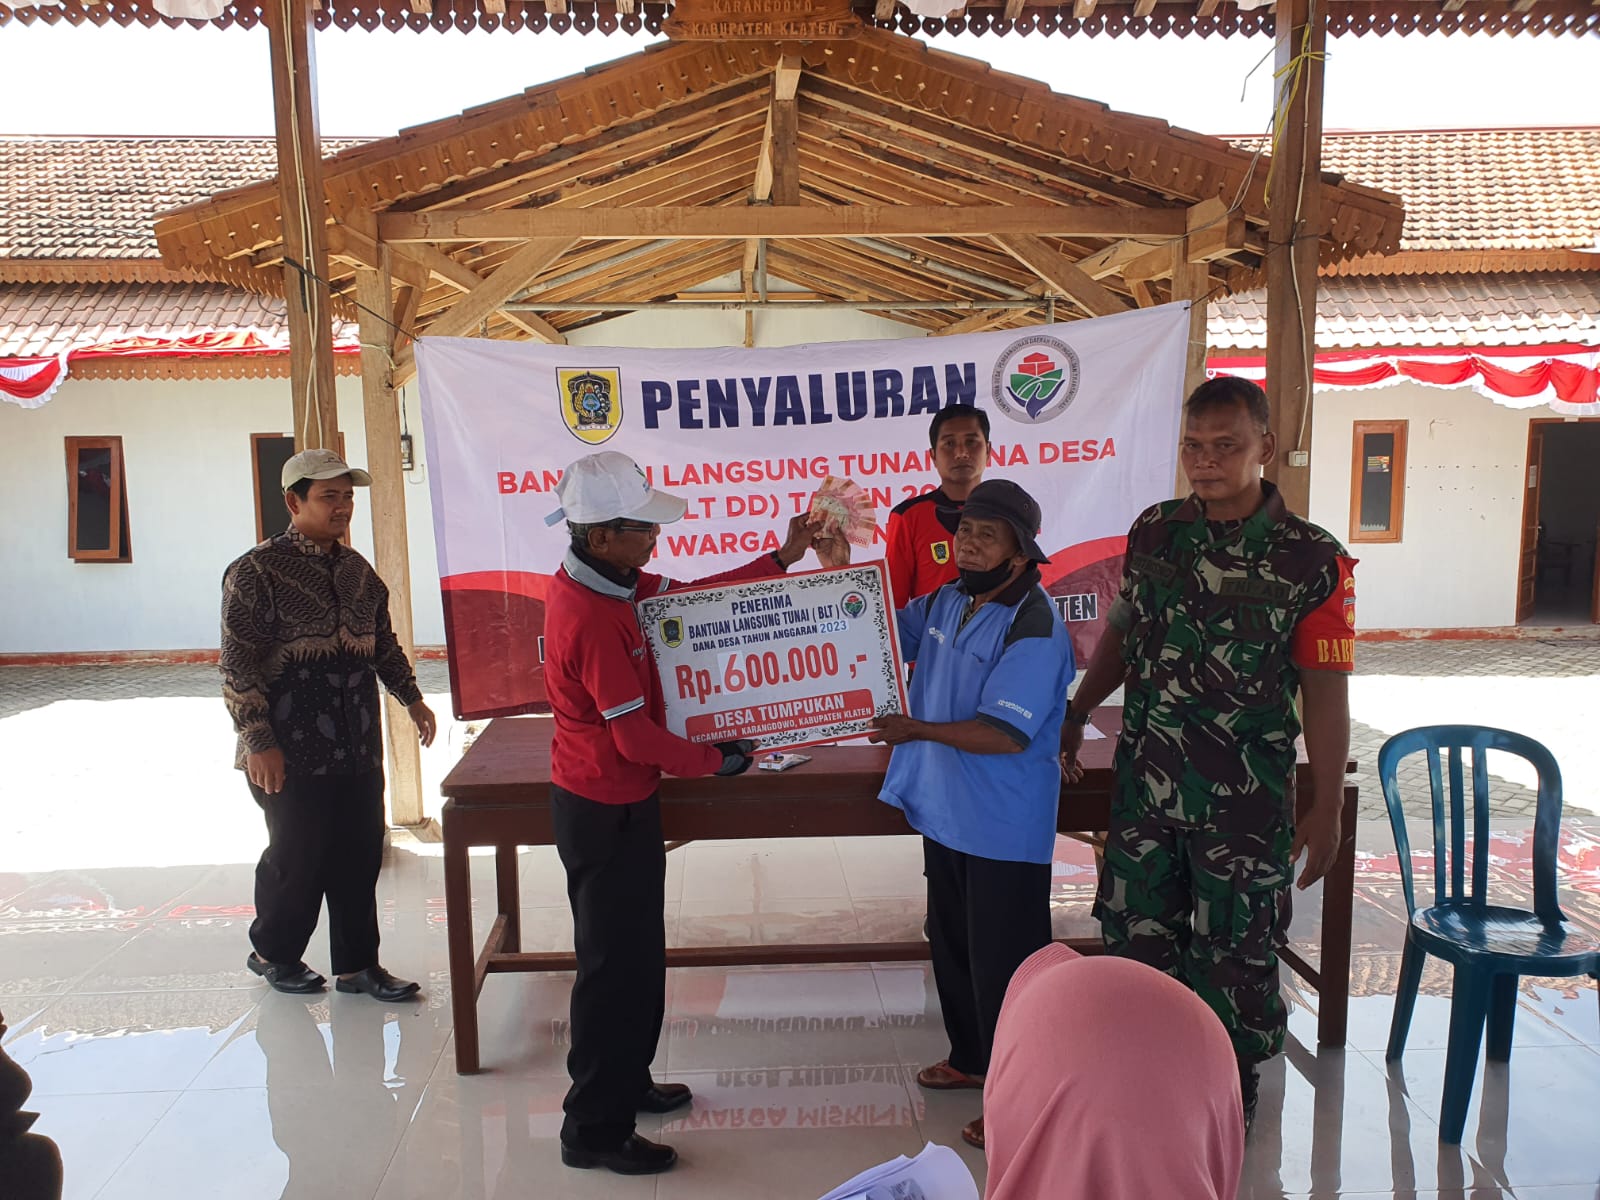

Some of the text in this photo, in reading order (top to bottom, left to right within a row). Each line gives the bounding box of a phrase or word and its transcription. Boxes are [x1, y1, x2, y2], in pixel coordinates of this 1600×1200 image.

[692, 21, 772, 36] KABUPATEN
[641, 362, 976, 429] PENYALURAN
[663, 456, 829, 487] LANGSUNG
[1039, 437, 1116, 464] DESA
[725, 494, 780, 519] DD)
[666, 530, 782, 557] WARGA
[731, 594, 793, 616] PENERIMA
[1053, 593, 1098, 622] TEN
[688, 619, 731, 640] BANTUAN
[733, 614, 781, 632] LANGSUNG
[782, 608, 810, 624] TUNAI
[692, 620, 848, 652] DANA DESA TAHUN ANGGARAN 2023
[690, 707, 872, 744] KECAMATAN KARANGDOWO, KABUPATEN KLATEN
[713, 694, 846, 729] DESA TUMPUKAN
